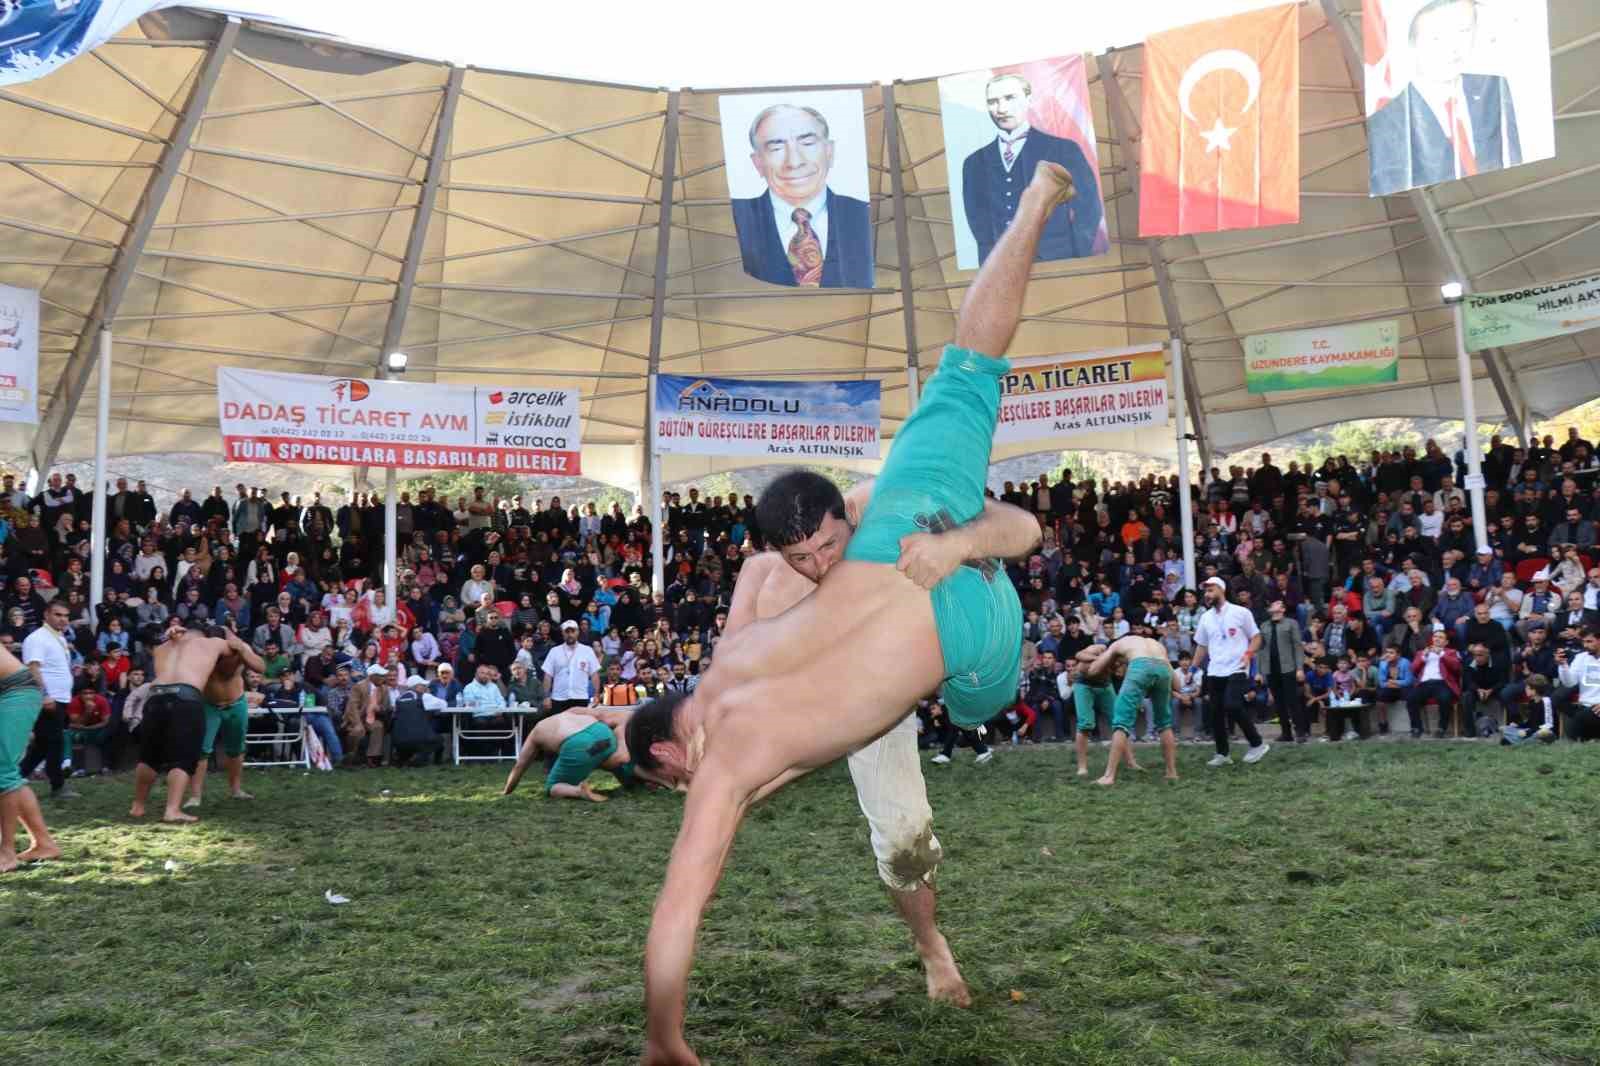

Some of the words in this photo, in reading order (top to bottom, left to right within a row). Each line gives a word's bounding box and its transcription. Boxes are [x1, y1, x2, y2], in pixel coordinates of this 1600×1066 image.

[1041, 361, 1132, 390] TİCARET
[508, 391, 567, 408] arçelik
[678, 396, 800, 414] ANADOLU
[1055, 393, 1116, 419] BAŞARILAR
[224, 401, 305, 427] DADAŞ
[316, 403, 411, 428] TİCARET
[419, 412, 469, 431] AVM
[507, 411, 573, 428] istikbal
[1053, 422, 1081, 431] Aras
[1085, 411, 1152, 427] ALTUNIŞIK
[658, 417, 694, 437] BÜTÜN
[771, 423, 830, 444] BAŞARILAR
[503, 433, 567, 449] karaca
[768, 444, 795, 454] Aras
[799, 444, 864, 458] ALTUNIŞIK
[231, 439, 272, 458] TÜM
[278, 442, 396, 465] SPORCULARA
[505, 450, 568, 471] DİLERİZ
